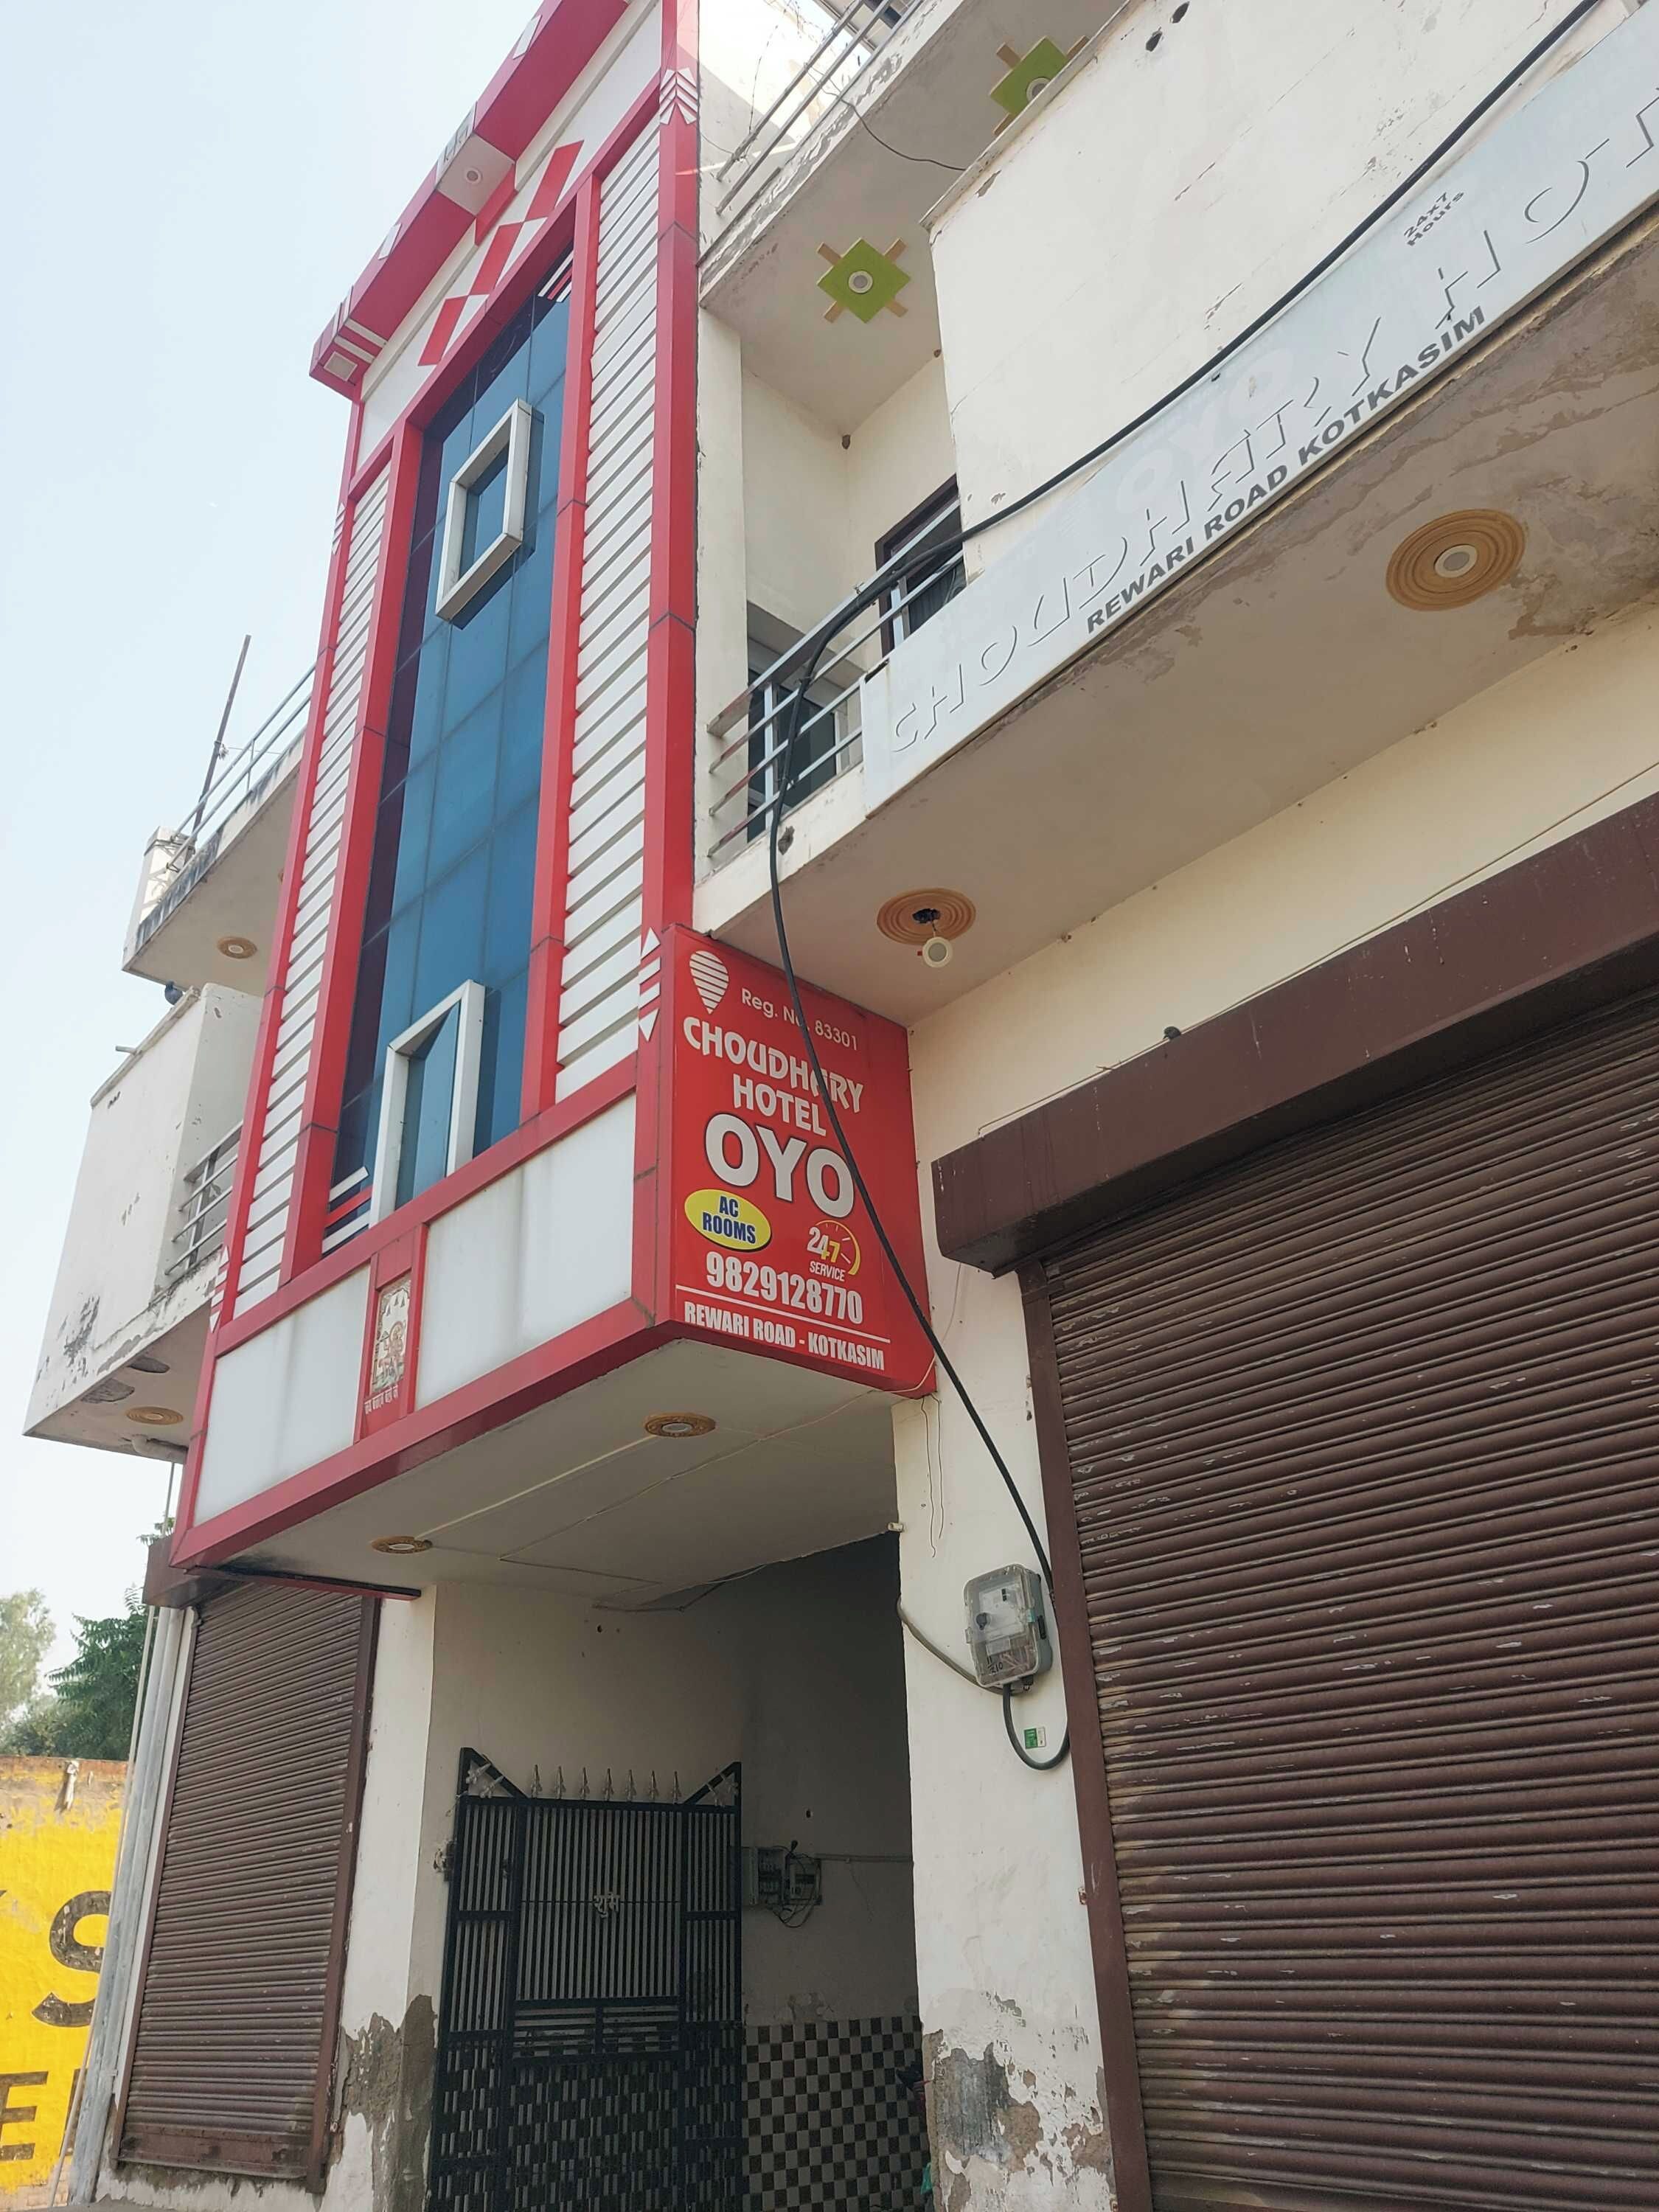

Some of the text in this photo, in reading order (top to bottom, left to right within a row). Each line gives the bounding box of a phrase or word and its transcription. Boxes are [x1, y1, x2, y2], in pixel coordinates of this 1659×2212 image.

[1087, 305, 1486, 633] REWARI ROAD KOTKASIM
[742, 988, 778, 1018] Reg.
[815, 1020, 858, 1051] 83301
[684, 1016, 864, 1113] CHOUDHARY
[733, 1073, 827, 1136] HOTEL
[705, 1113, 855, 1218] OYO
[702, 1211, 757, 1244] ROOMS
[719, 1196, 738, 1217] AC
[706, 1251, 863, 1324] 9829128770
[809, 1260, 846, 1281] SERVICE
[684, 1301, 749, 1337] REWARI
[754, 1318, 796, 1348] ROAD
[808, 1332, 885, 1371] KOTKASIM
